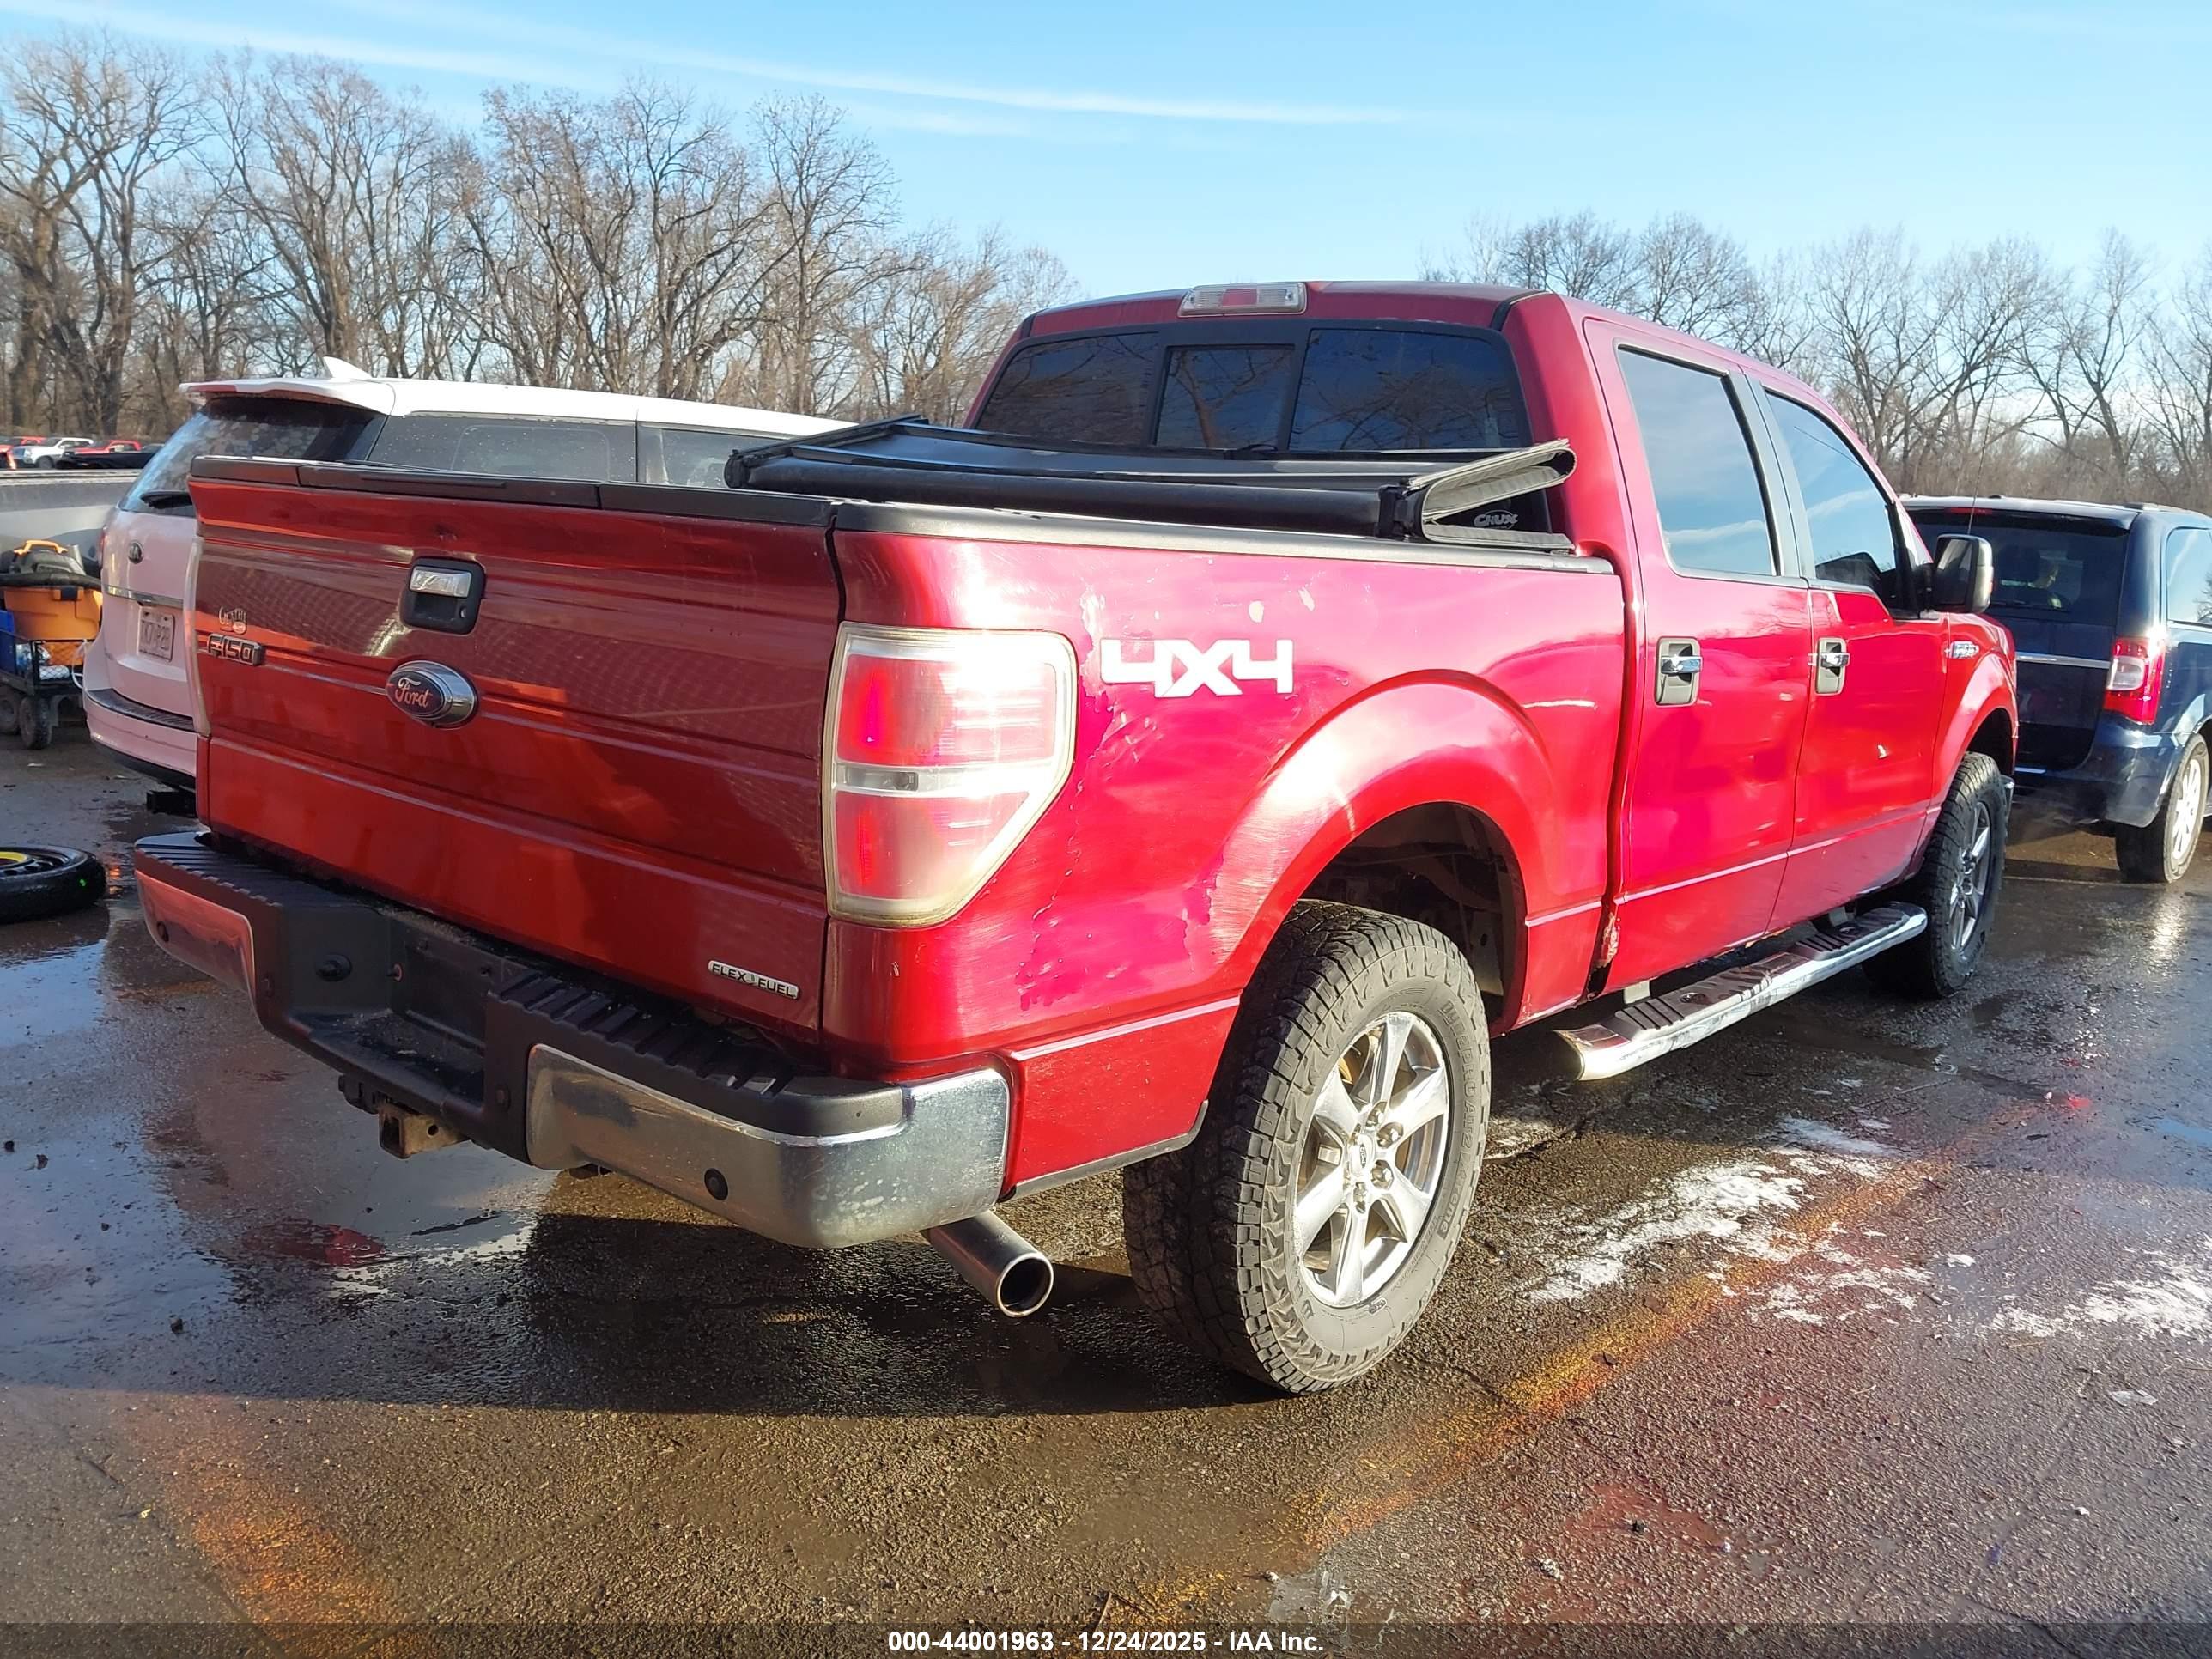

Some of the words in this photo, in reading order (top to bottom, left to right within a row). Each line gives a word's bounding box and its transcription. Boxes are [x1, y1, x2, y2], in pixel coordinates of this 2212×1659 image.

[395, 677, 433, 708] Ford
[712, 963, 746, 983] FLEX
[757, 977, 797, 997] FUEL
